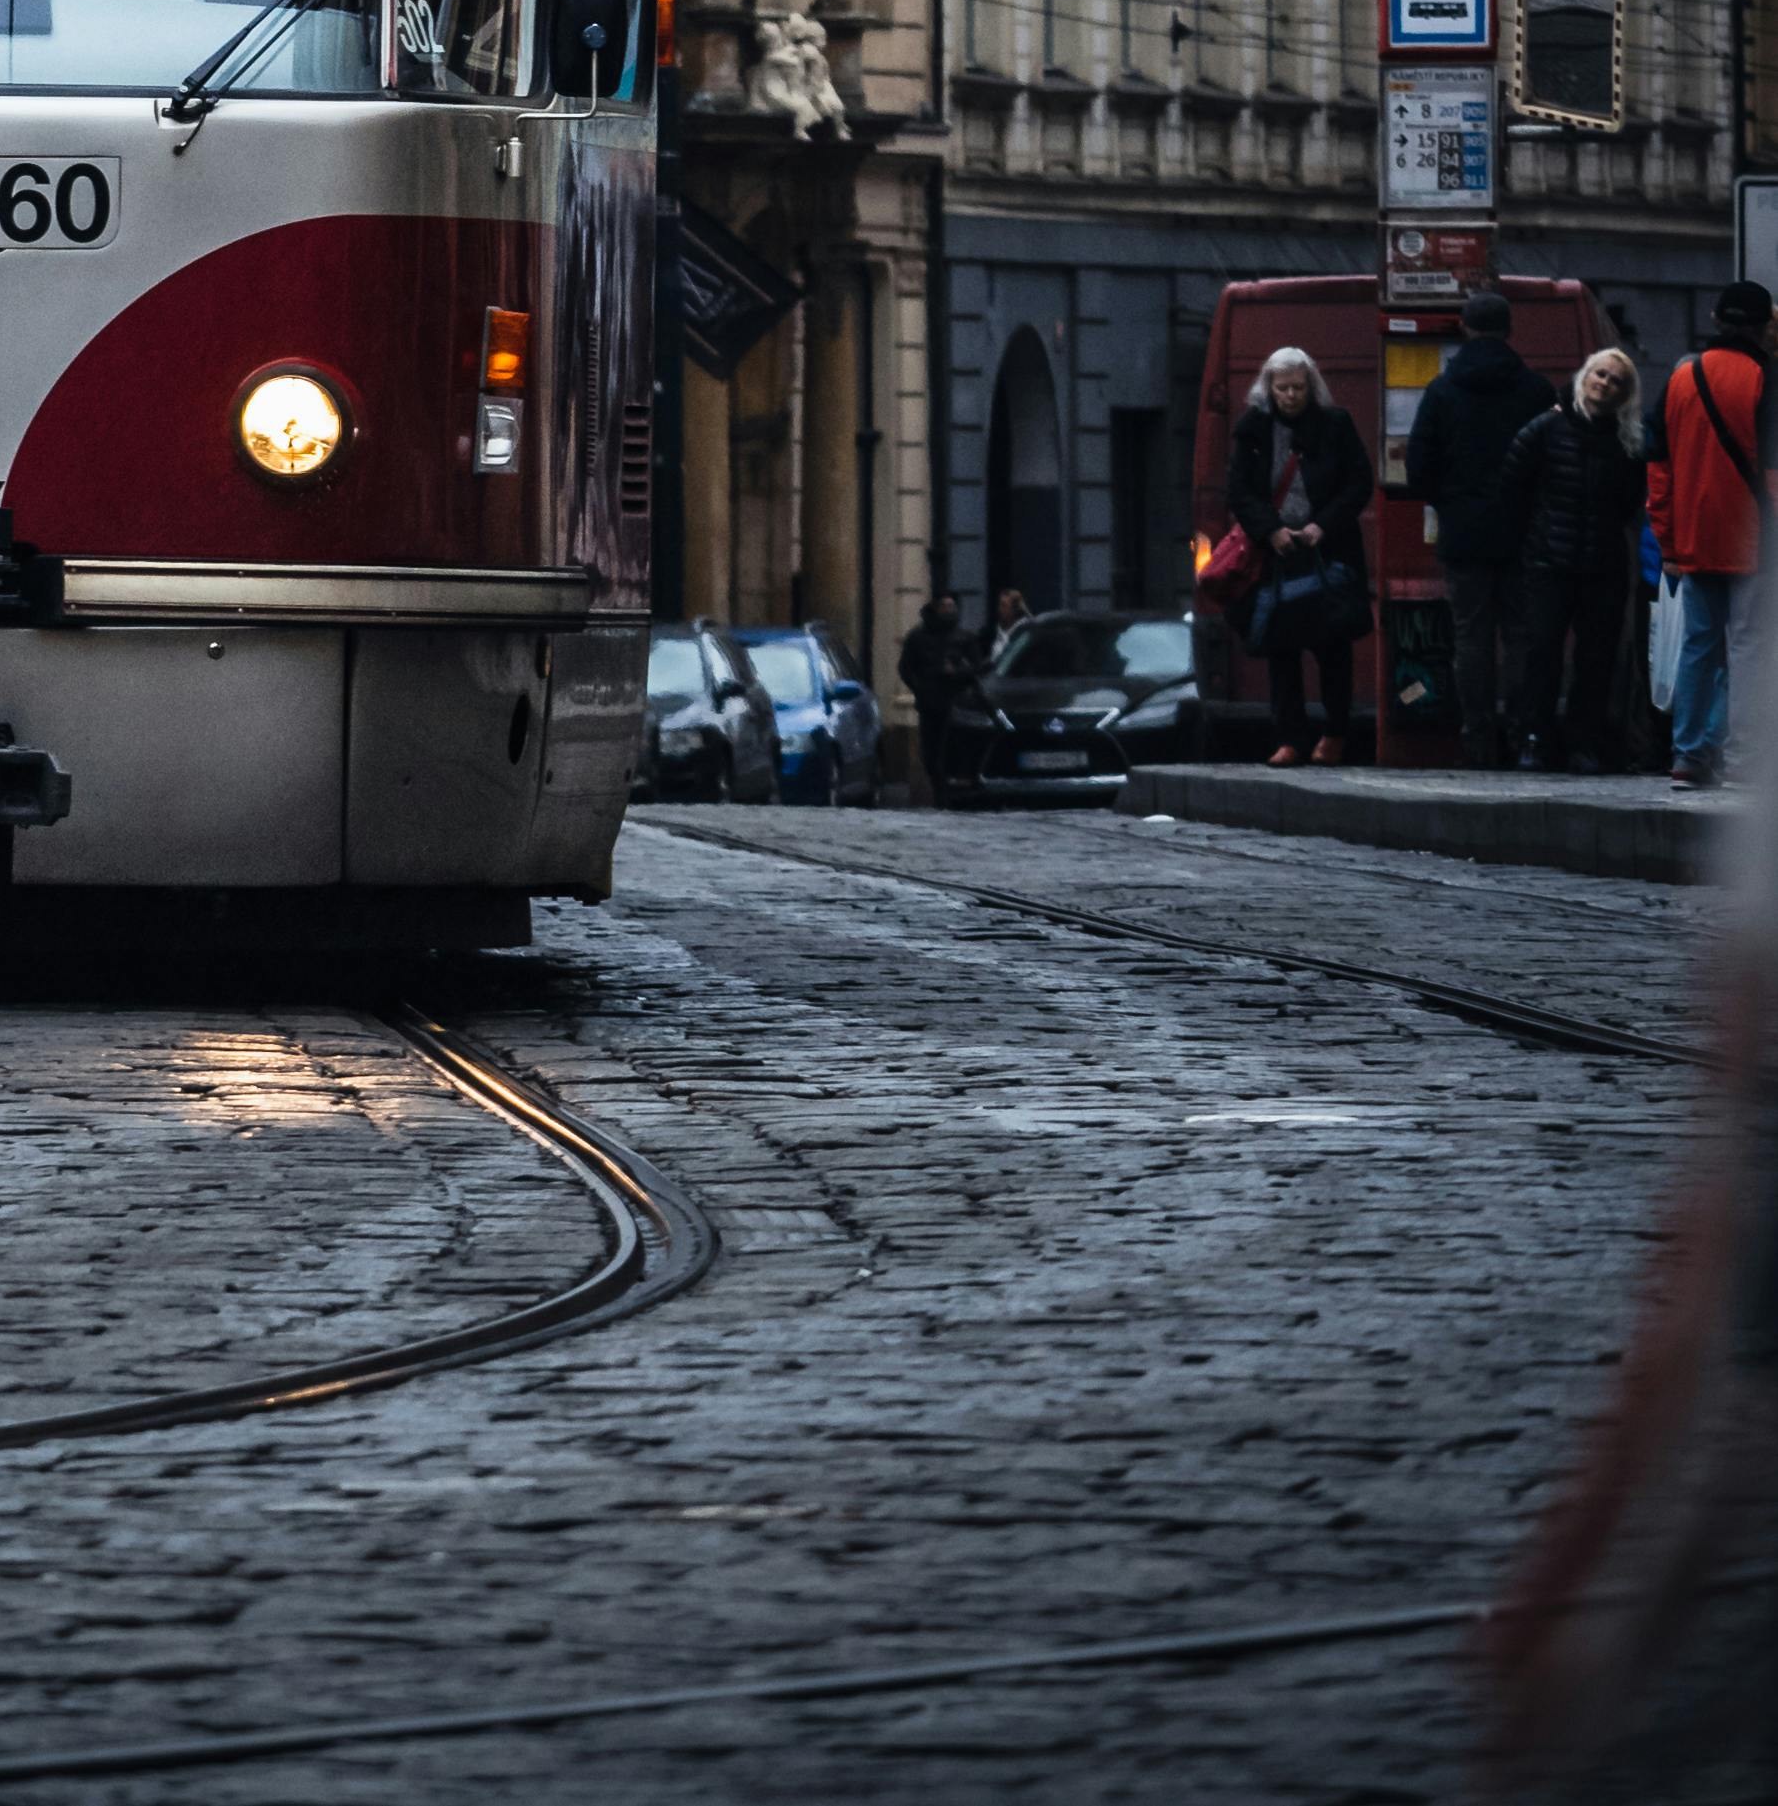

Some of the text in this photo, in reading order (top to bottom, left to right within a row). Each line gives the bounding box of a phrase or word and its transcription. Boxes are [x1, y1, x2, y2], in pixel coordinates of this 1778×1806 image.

[1421, 103, 1431, 119] 8
[1418, 133, 1436, 148] 15
[1440, 134, 1460, 149] 91
[1396, 154, 1407, 169] 6
[1416, 153, 1436, 168] 26
[1440, 154, 1460, 167] 94
[1440, 173, 1460, 188] 96
